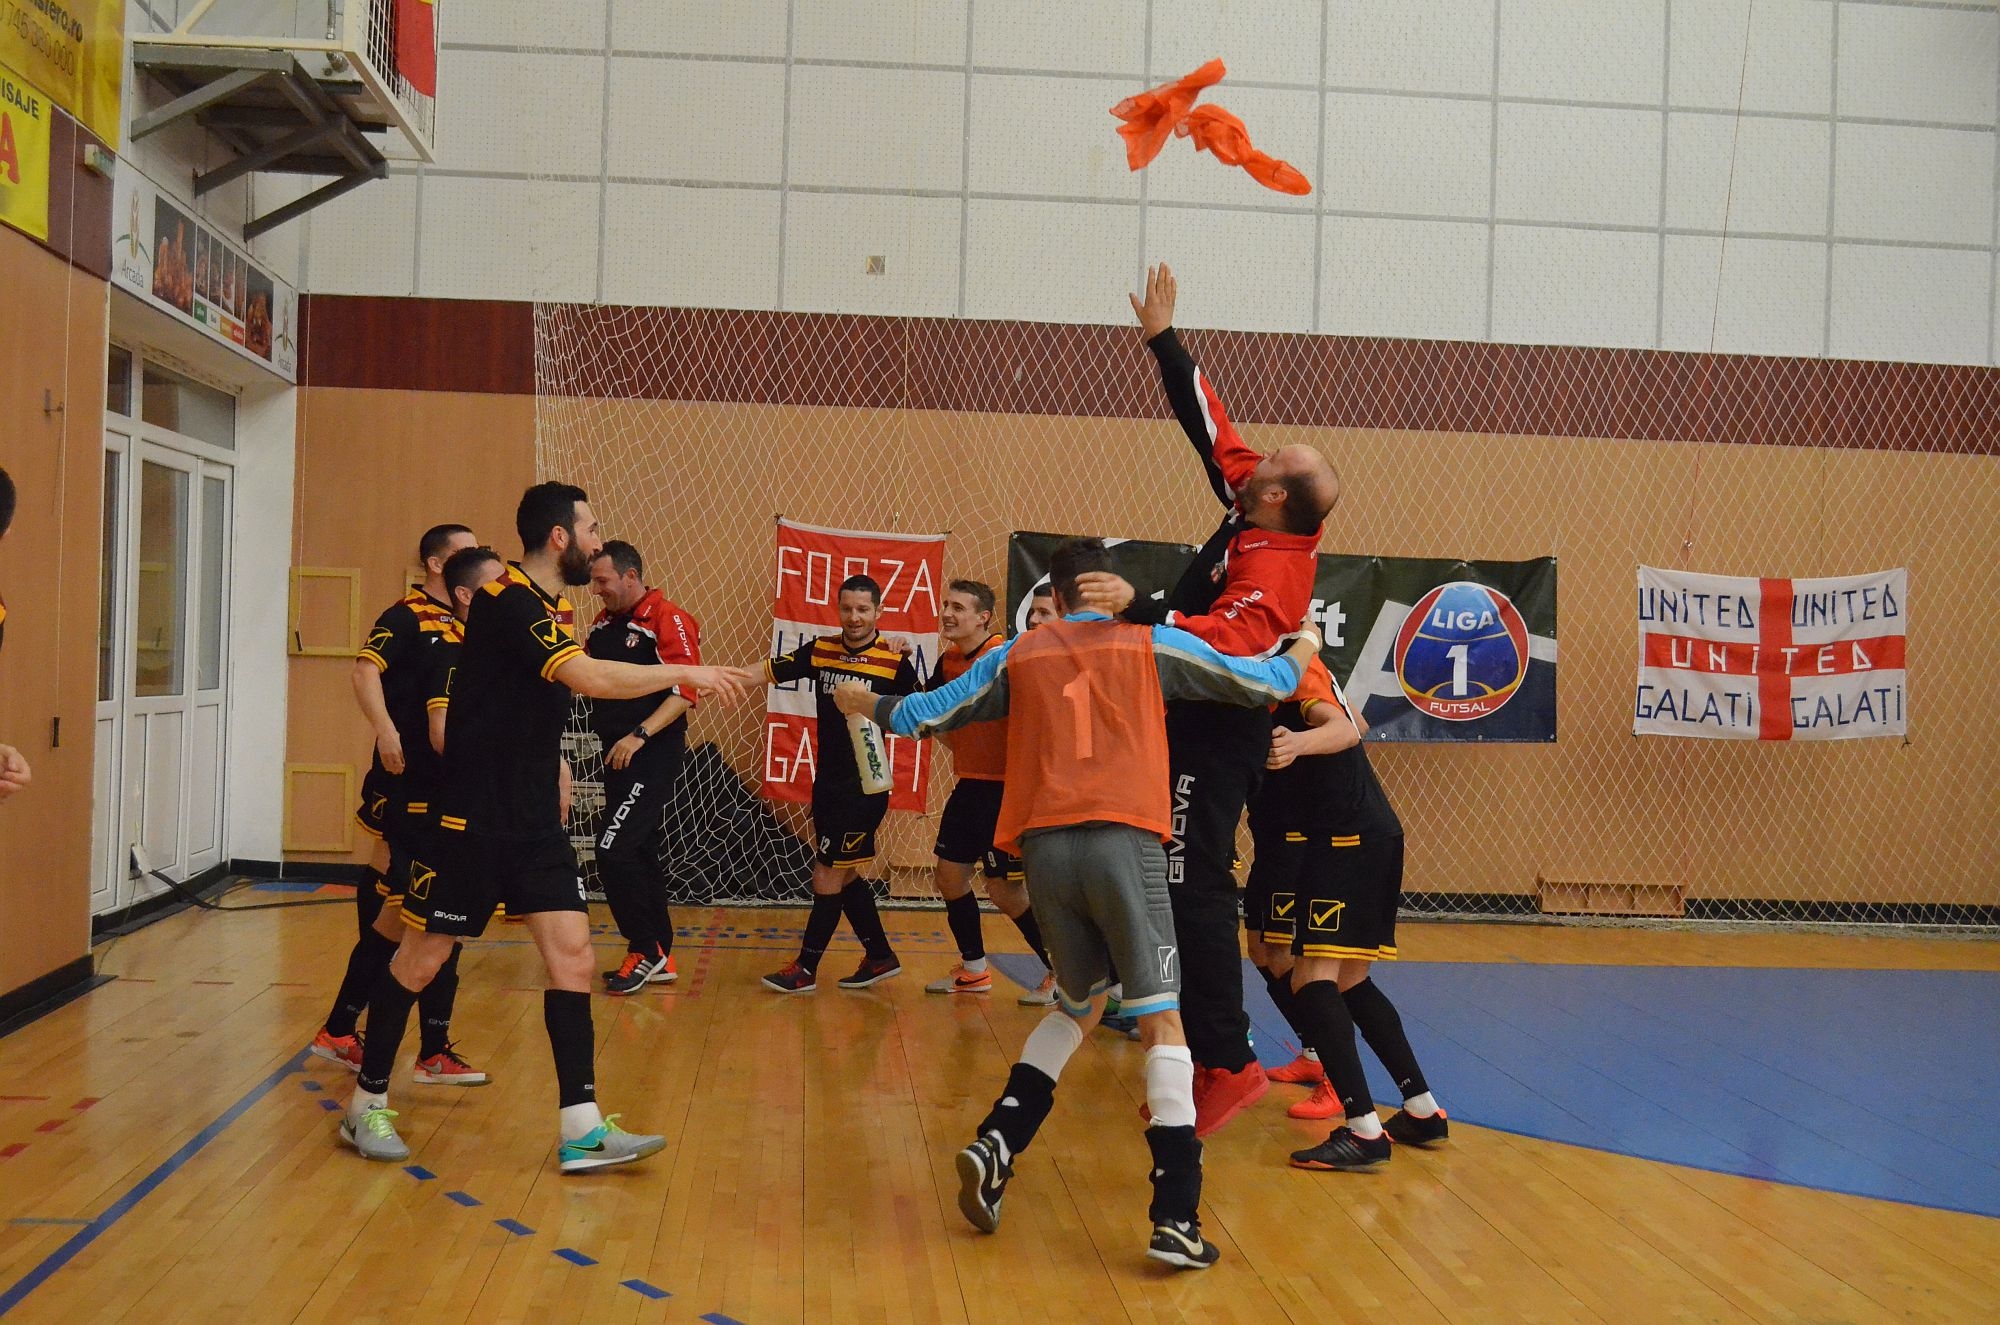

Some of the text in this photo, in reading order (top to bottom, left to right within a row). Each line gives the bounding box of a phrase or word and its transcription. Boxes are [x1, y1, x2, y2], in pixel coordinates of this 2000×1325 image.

[121, 258, 144, 289] Arcada
[1431, 608, 1494, 631] LIGA
[1446, 644, 1468, 696] 1
[1063, 671, 1092, 760] 1
[1430, 701, 1491, 714] FUTSAL
[766, 722, 924, 795] GATI
[600, 782, 644, 849] GIVOVA
[1169, 774, 1196, 884] GIVOVA
[434, 910, 467, 922] GIVOVA
